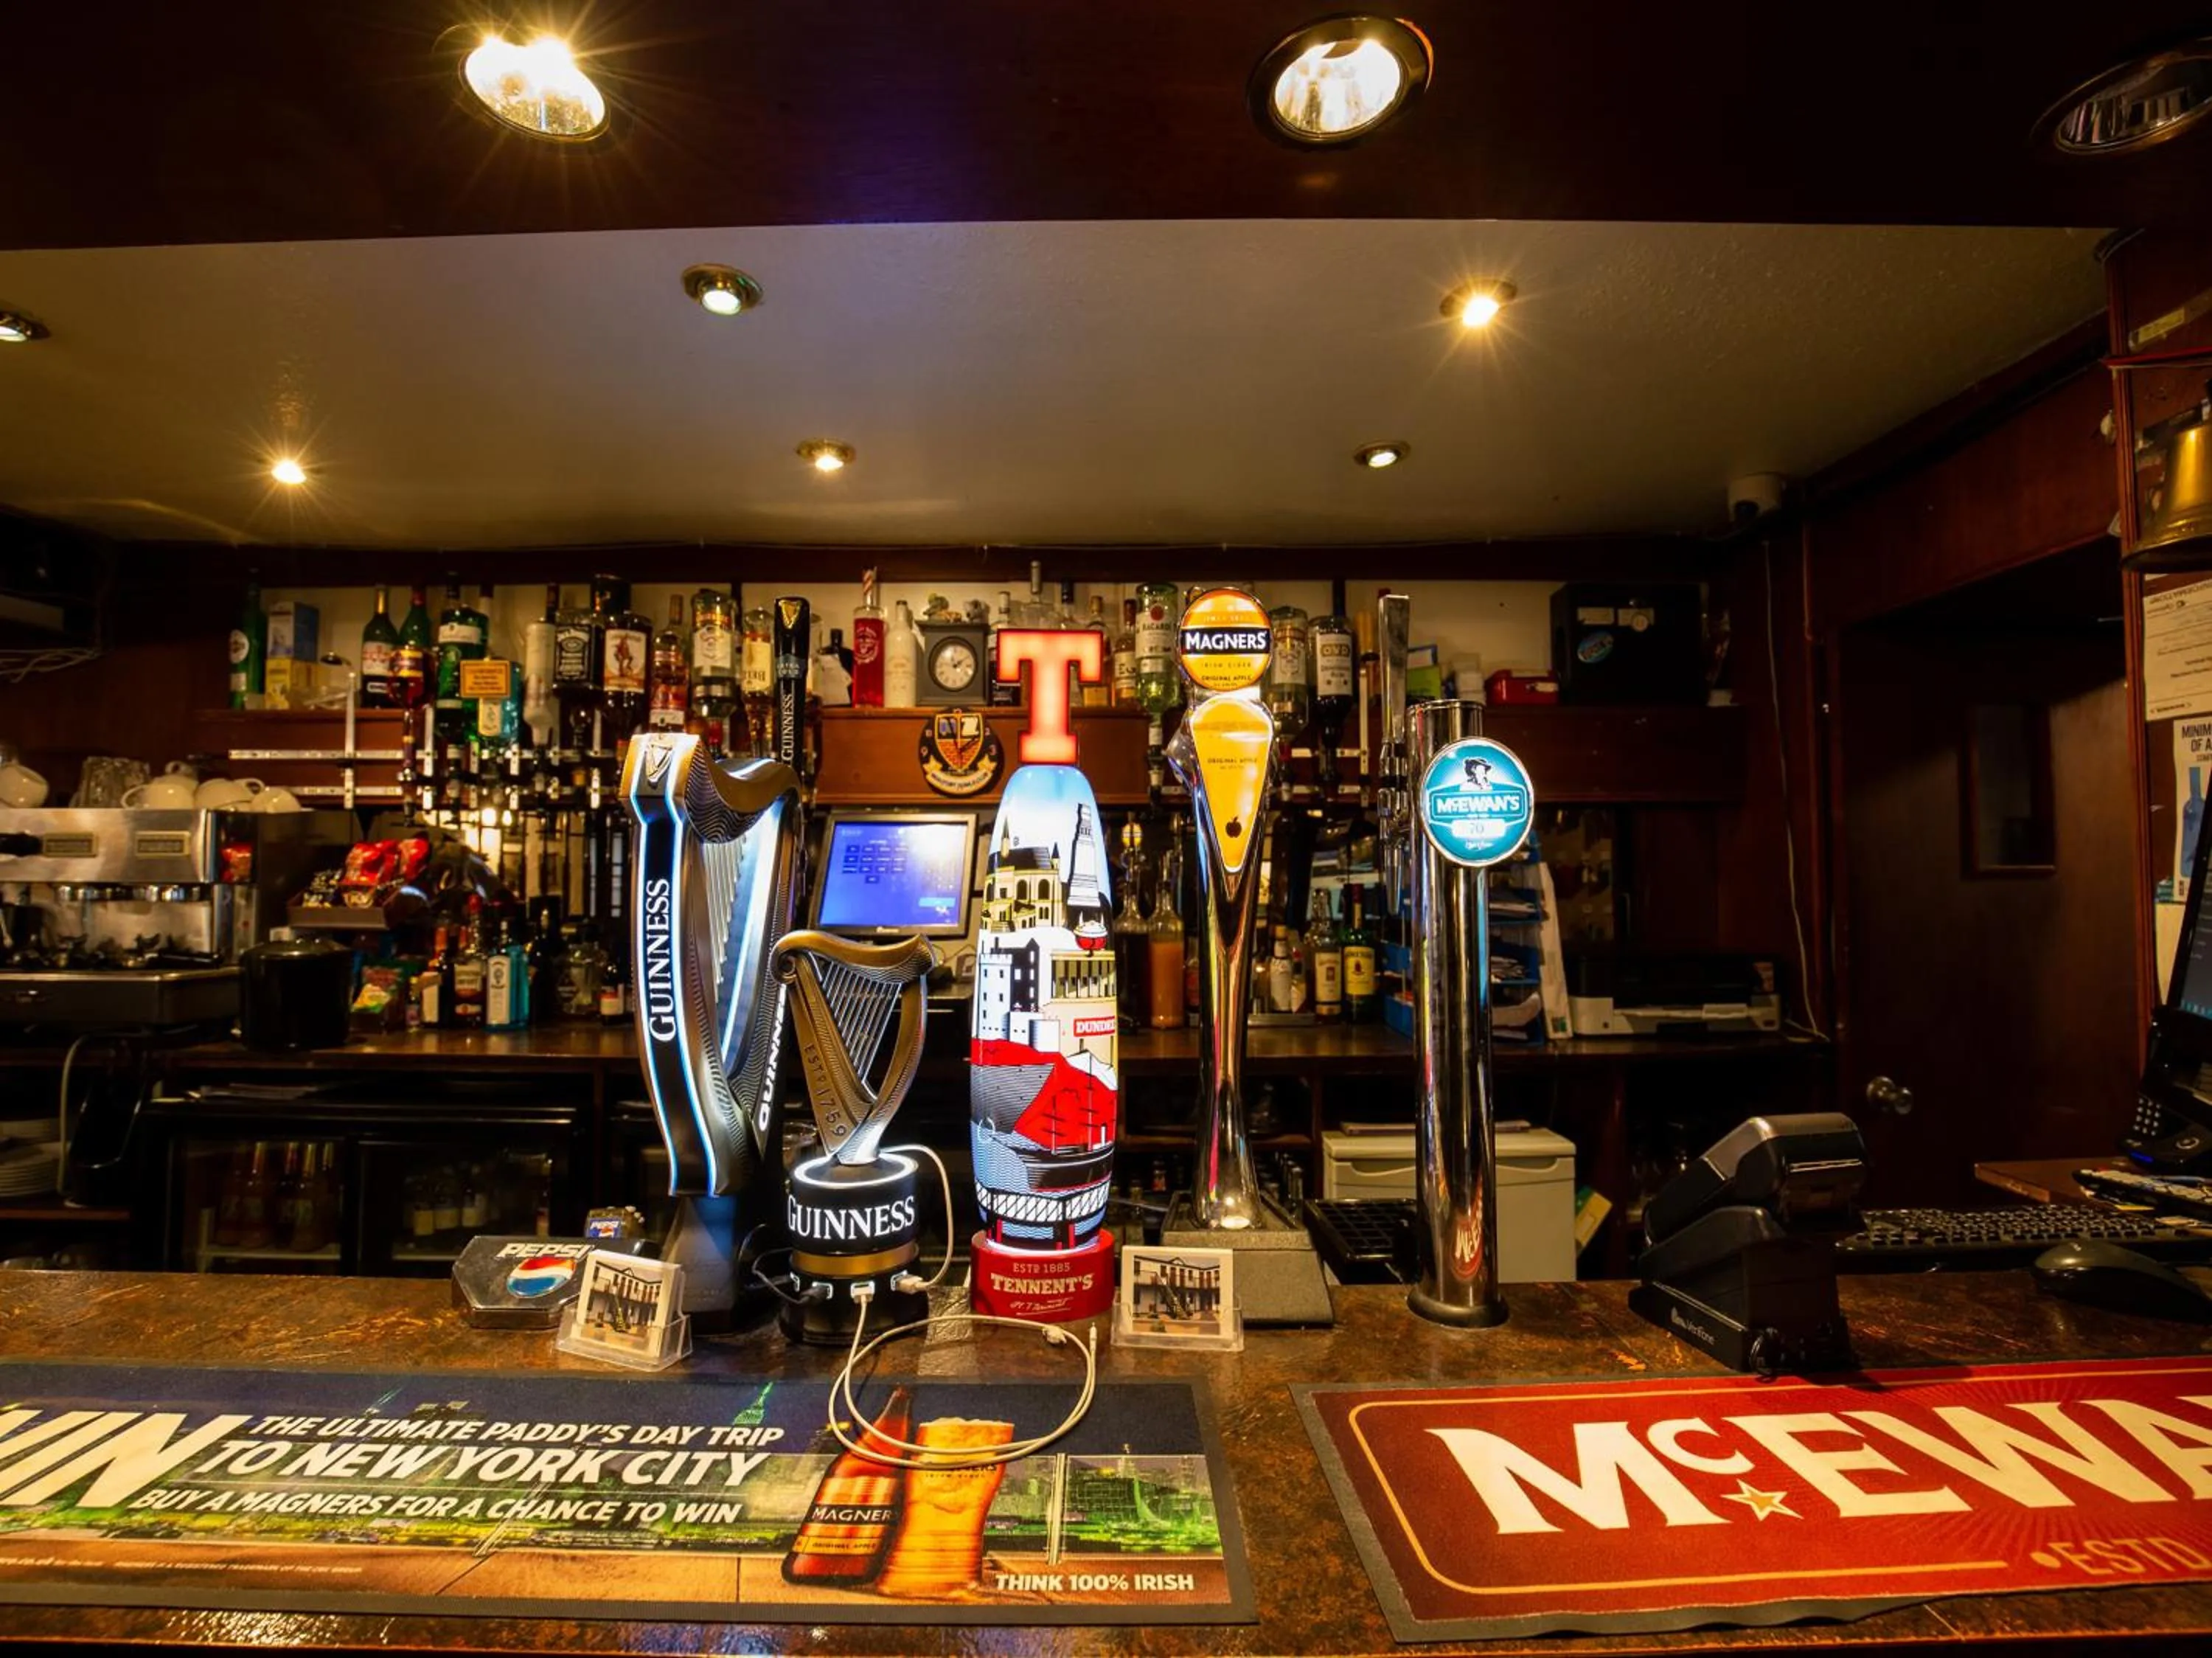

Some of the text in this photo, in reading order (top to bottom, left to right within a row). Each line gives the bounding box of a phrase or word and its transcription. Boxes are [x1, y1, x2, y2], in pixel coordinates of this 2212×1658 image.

[1185, 631, 1266, 650] MAGNERS
[781, 694, 795, 763] GUINNESS
[646, 878, 676, 1041] GUINNESS
[816, 1089, 847, 1137] 1759
[788, 1194, 914, 1240] GUINNESS
[496, 1243, 593, 1258] PEPSI
[1043, 1262, 1071, 1273] 1885
[990, 1272, 1095, 1294] TENNENT'S
[249, 1416, 785, 1446] THE ULTIMATE PADDY'S DAY TRIP
[193, 1440, 772, 1487] TO NEW YORK CITY
[1424, 1395, 2212, 1535] McEWA
[127, 1489, 742, 1523] BUY A MAGNERS FOR A CHANCE TO WIN
[995, 1574, 1194, 1591] THINK 100% IRISH
